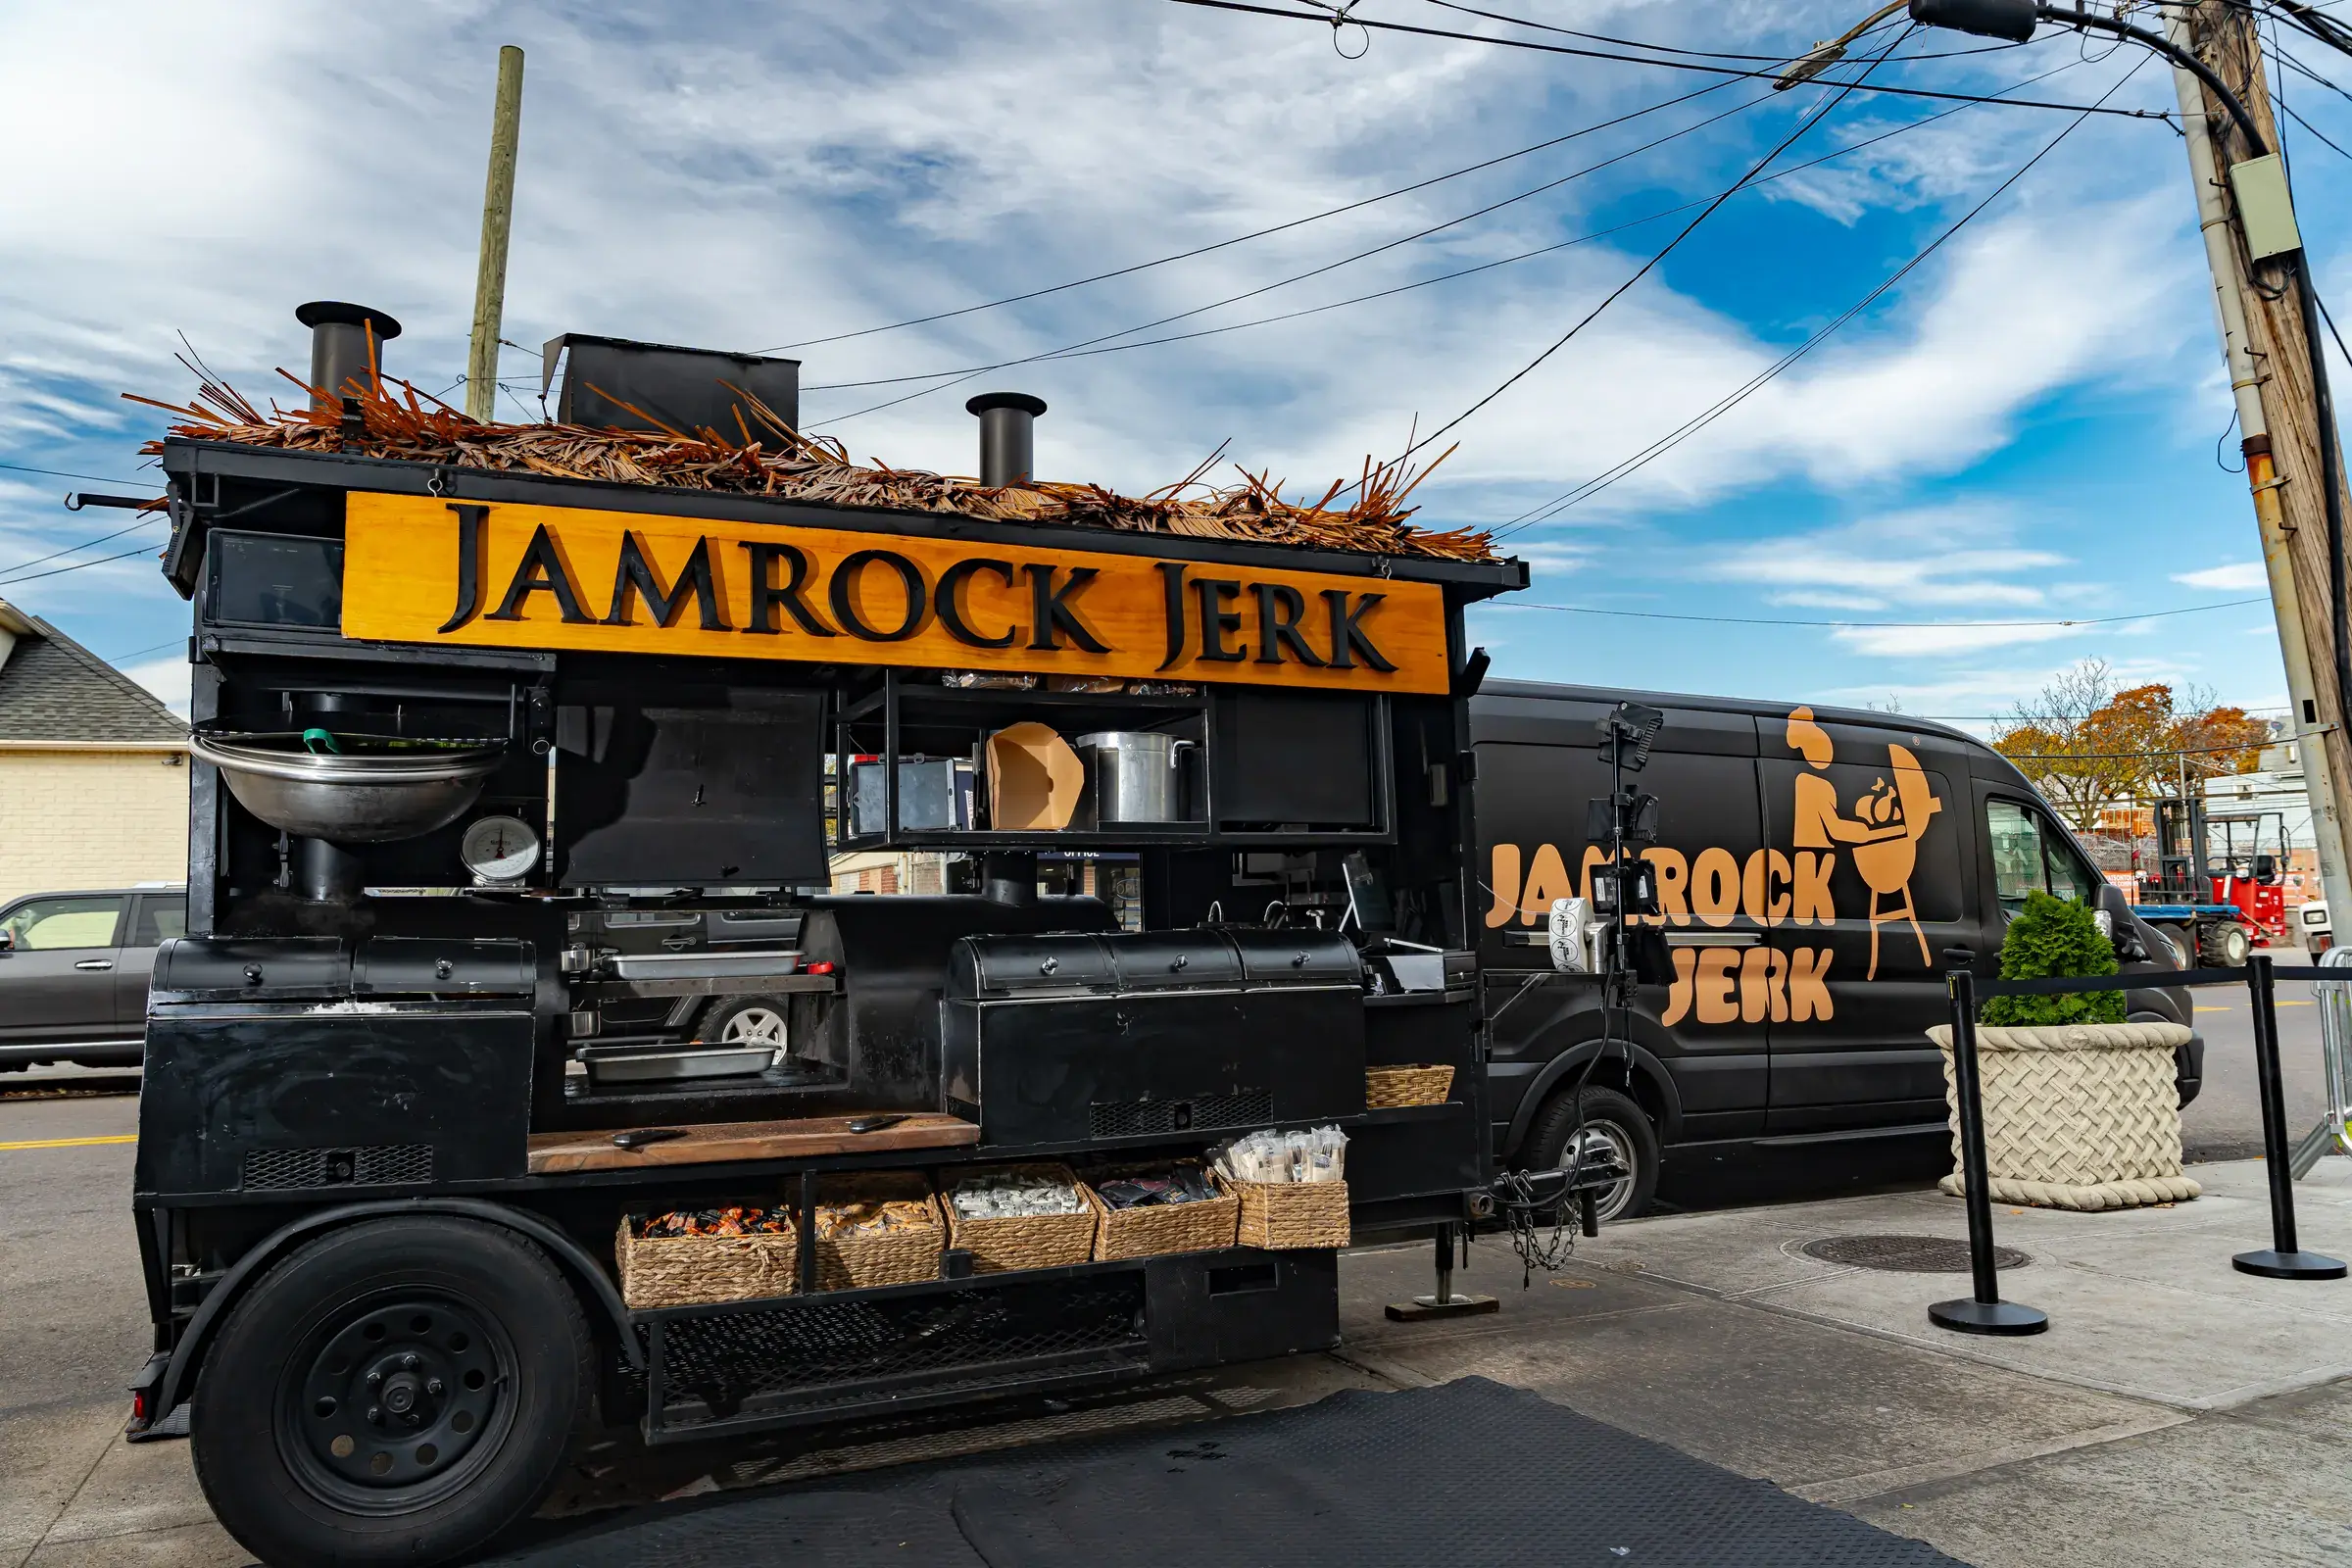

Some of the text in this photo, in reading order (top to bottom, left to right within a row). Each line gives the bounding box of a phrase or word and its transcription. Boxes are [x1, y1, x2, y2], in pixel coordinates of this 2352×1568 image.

[437, 503, 1399, 672] JAMROCK JERK
[1662, 948, 1834, 1027] JERK
